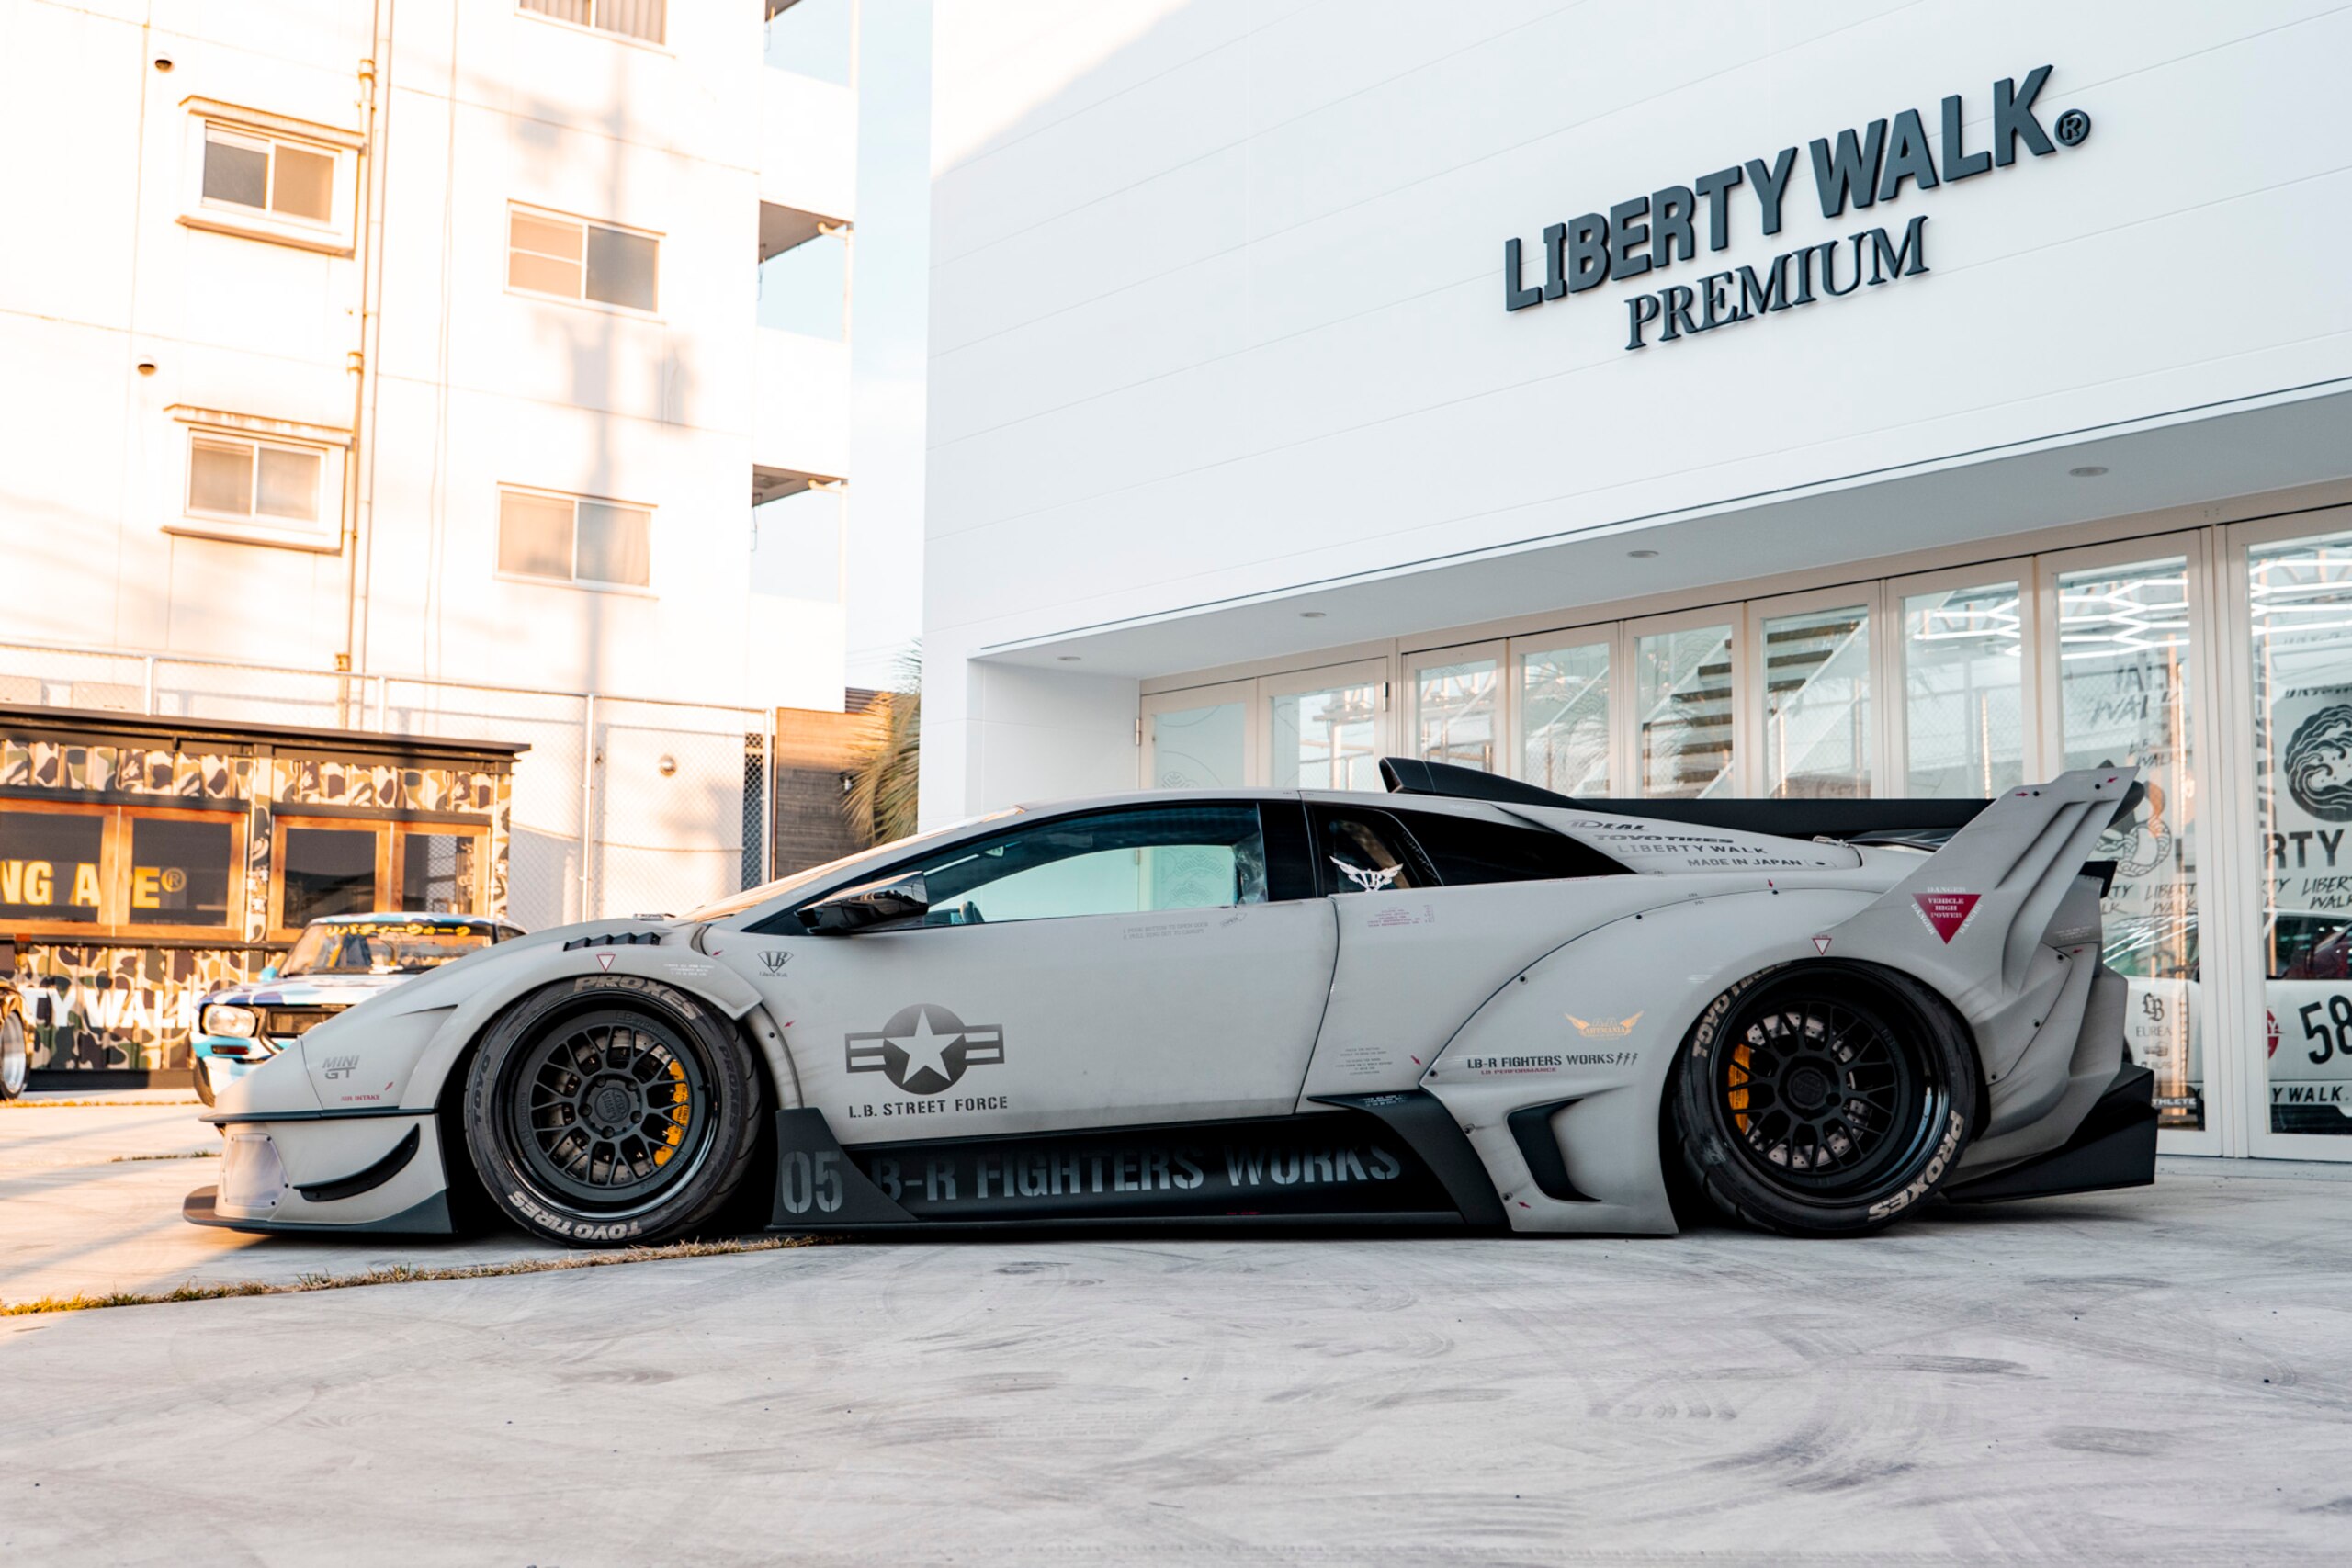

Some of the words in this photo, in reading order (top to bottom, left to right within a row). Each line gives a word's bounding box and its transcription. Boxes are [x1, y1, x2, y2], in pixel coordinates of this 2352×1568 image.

[1505, 146, 1798, 311] LIBERTY
[1624, 215, 1929, 351] PREMIUM
[1594, 834, 1663, 842] TOYO
[1665, 835, 1734, 844] TIRES
[1617, 844, 1704, 853] LIBERTY
[1711, 845, 1769, 854] WALK
[1687, 858, 1730, 867] MADE
[1732, 858, 1748, 866] IN
[1753, 858, 1802, 866] JAPAN
[573, 975, 704, 1020] PROXES
[1692, 993, 1731, 1058] TOYO
[2298, 994, 2352, 1065] 58
[322, 1055, 360, 1068] MINI
[324, 1066, 356, 1079] GT
[1467, 1057, 1498, 1069] LB-R
[1501, 1055, 1562, 1067] FIGHTERS
[1494, 1066, 1557, 1075] PERFORMANCE
[472, 1054, 492, 1129] TOYO
[849, 1104, 877, 1118] L.B.
[883, 1100, 946, 1116] STREET
[955, 1095, 1008, 1111] FORCE
[781, 1151, 843, 1213] 05
[977, 1146, 1204, 1199] FIGHTERS
[1224, 1144, 1402, 1187] WORKS
[1868, 1110, 1964, 1223] PROXES
[507, 1190, 572, 1236] TIRES
[572, 1218, 644, 1241] TOYO
